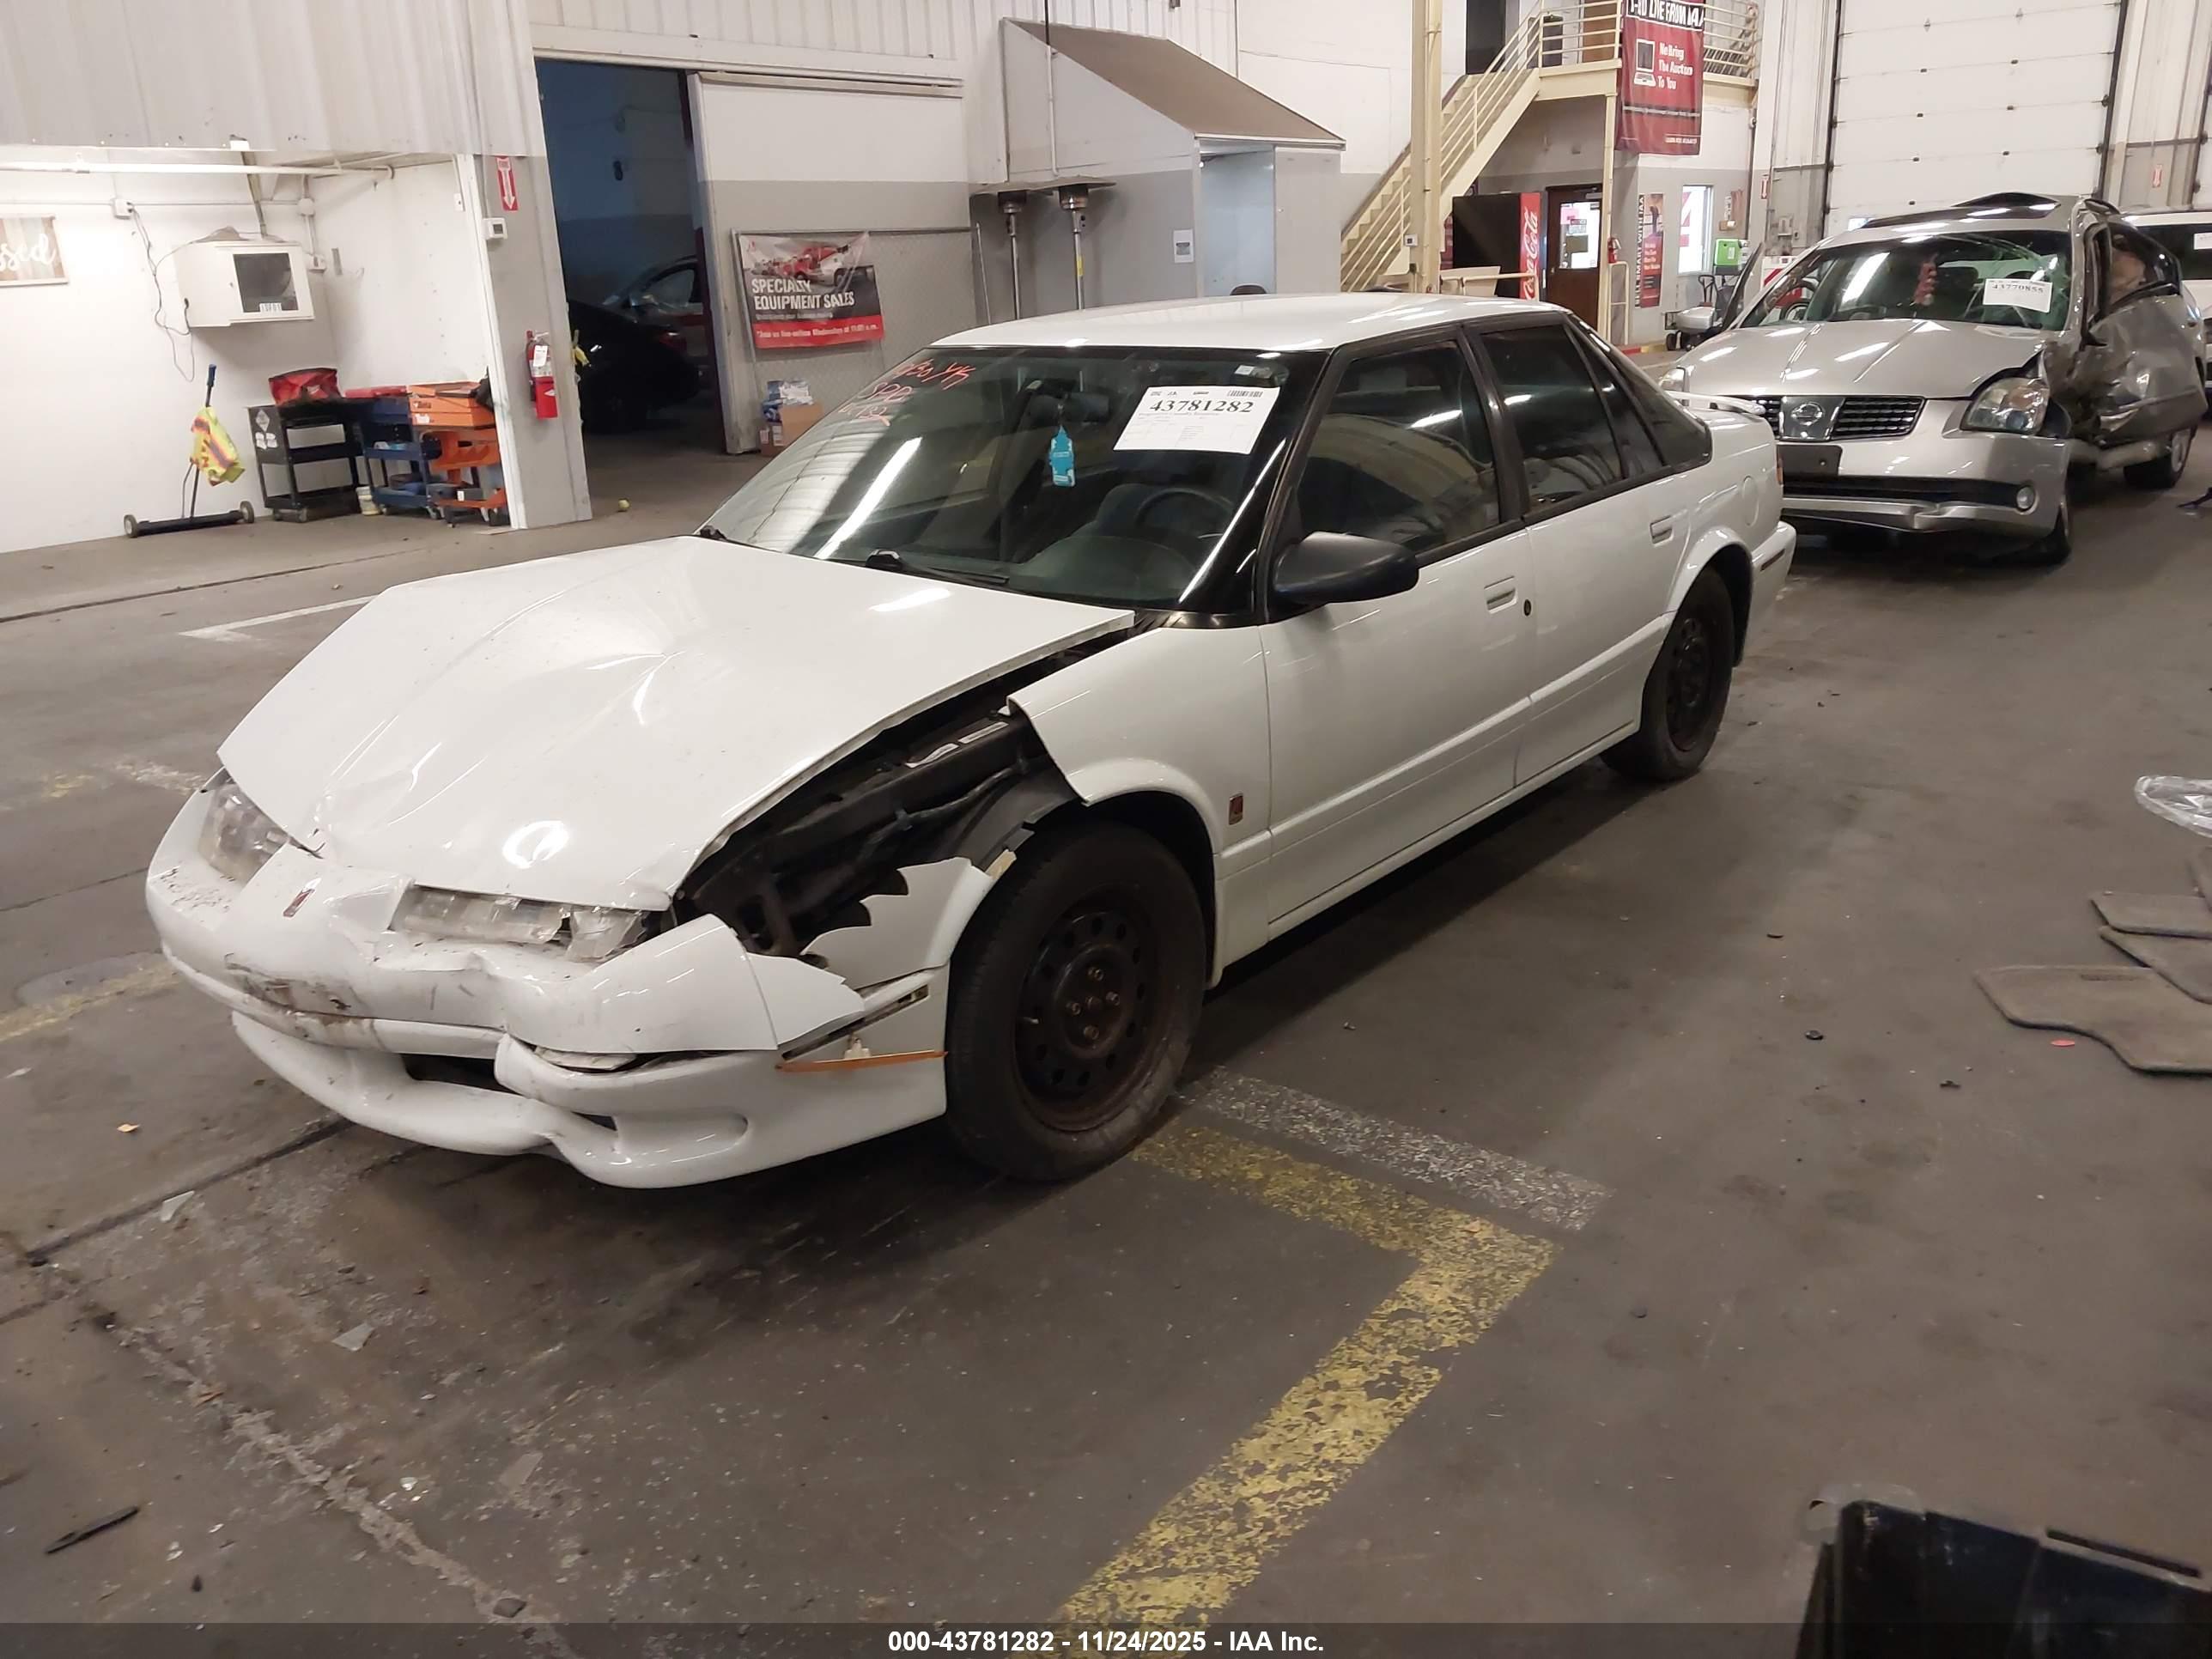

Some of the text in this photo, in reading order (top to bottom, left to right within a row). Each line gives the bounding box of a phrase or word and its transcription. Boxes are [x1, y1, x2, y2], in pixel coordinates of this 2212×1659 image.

[1659, 59, 1668, 72] The
[1657, 76, 1677, 89] To You
[751, 278, 811, 294] SPECIALTY
[754, 291, 854, 310] EQUIPMENT SALES
[1149, 399, 1255, 413] 43781282
